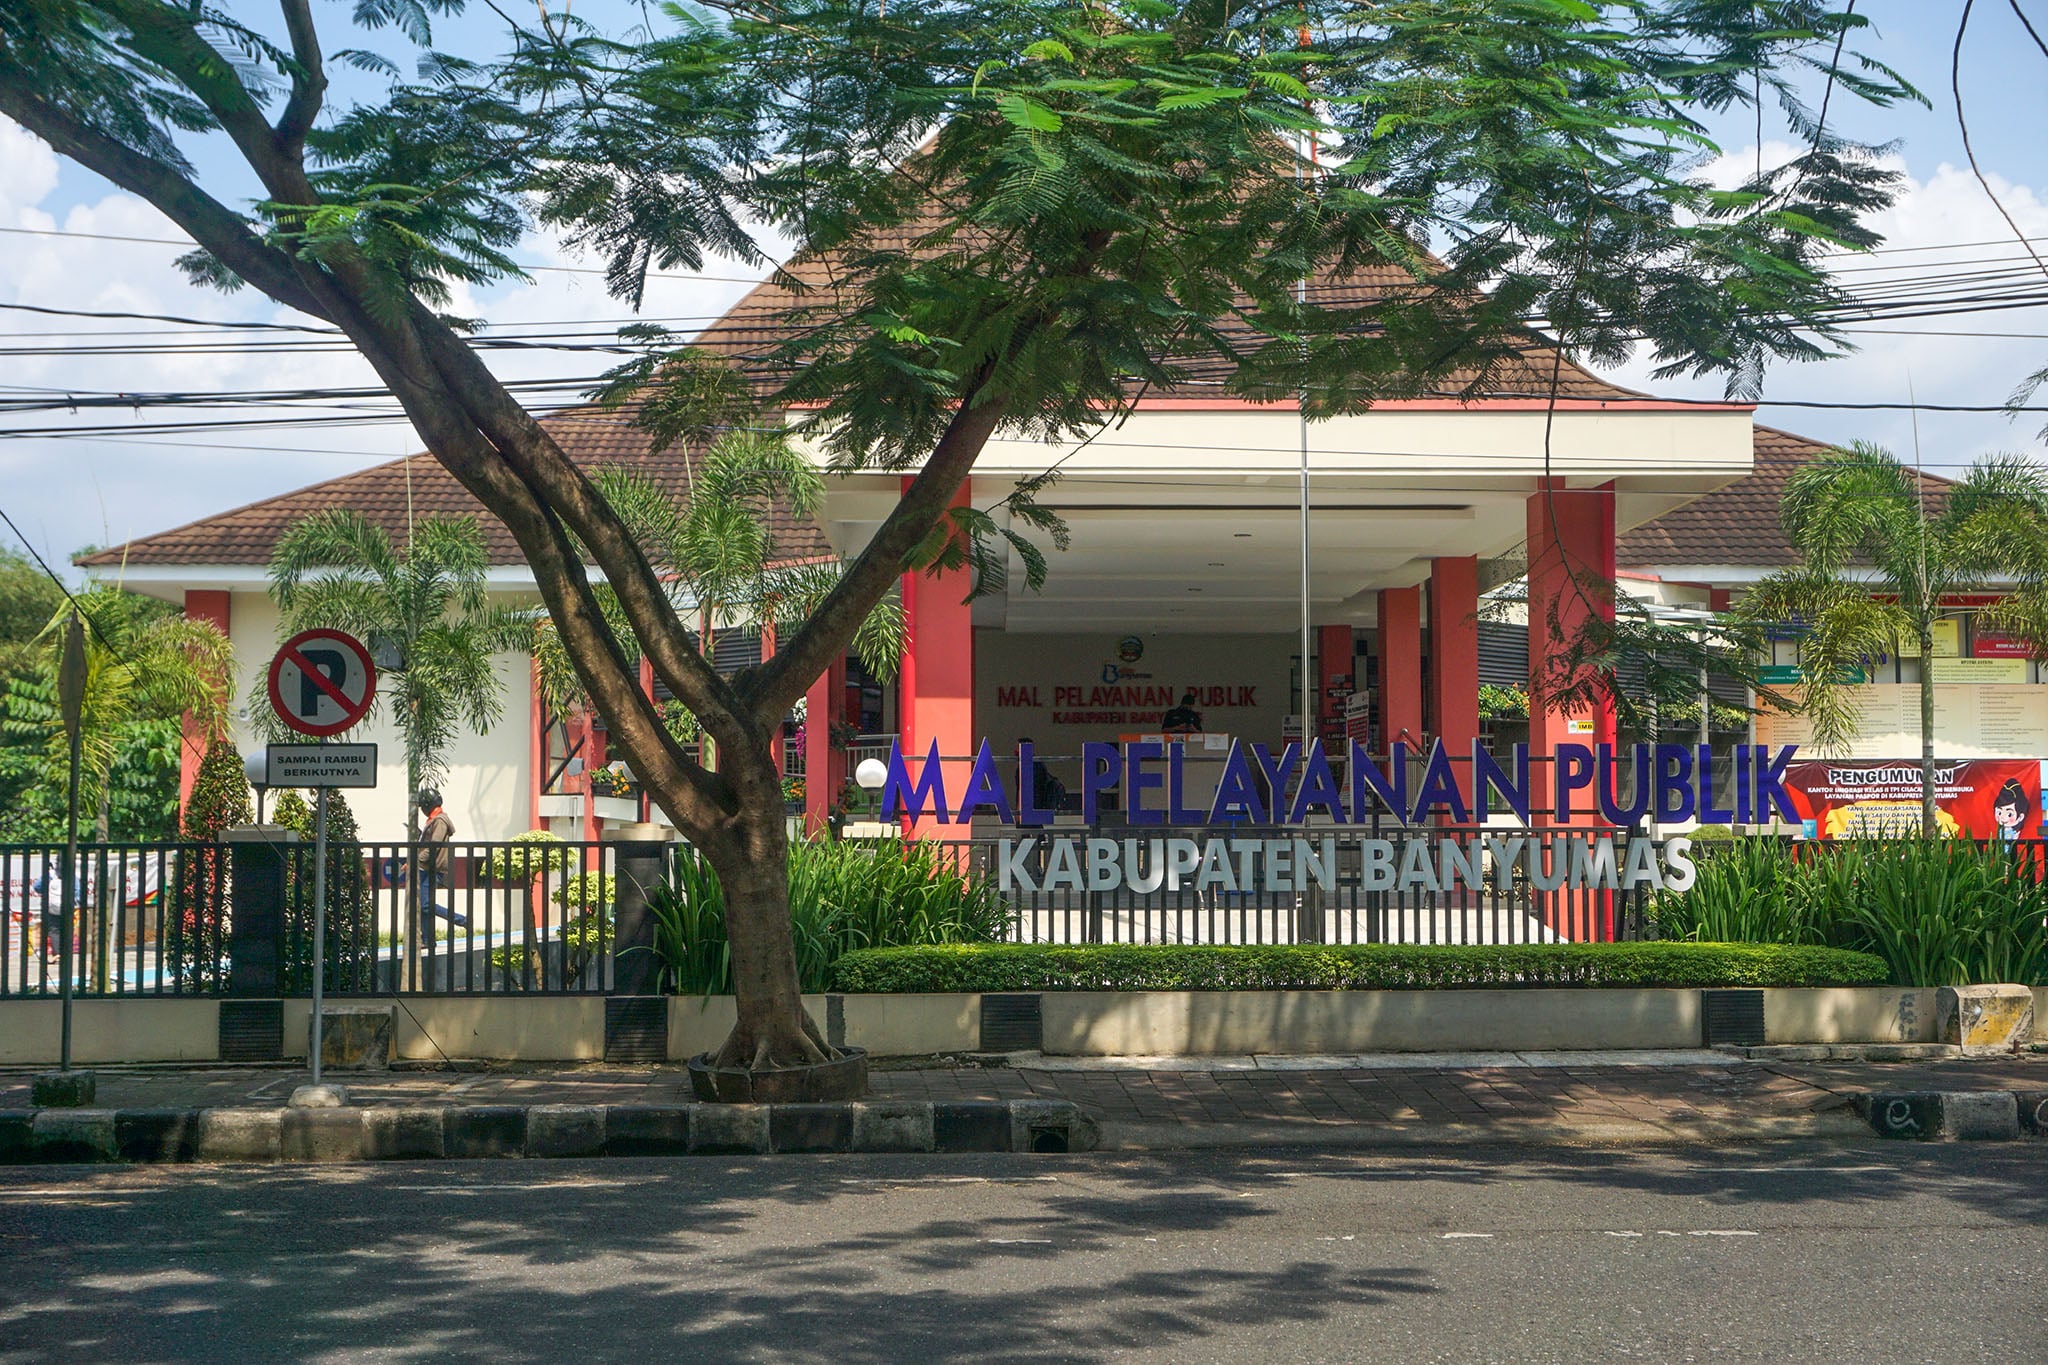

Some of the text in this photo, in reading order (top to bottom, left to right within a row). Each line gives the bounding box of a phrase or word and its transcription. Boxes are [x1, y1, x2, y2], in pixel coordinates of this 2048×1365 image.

[998, 686, 1257, 707] MAL PELAYANAN PUBLIK
[1053, 711, 1126, 724] KABUPATEN
[277, 755, 367, 764] SAMPAI RAMBU
[284, 768, 360, 777] BERIKUTNYA
[878, 736, 1802, 828] MAL PELAYANAN PUBLIK
[999, 837, 1697, 894] KABUPATEN BANYUMAS
